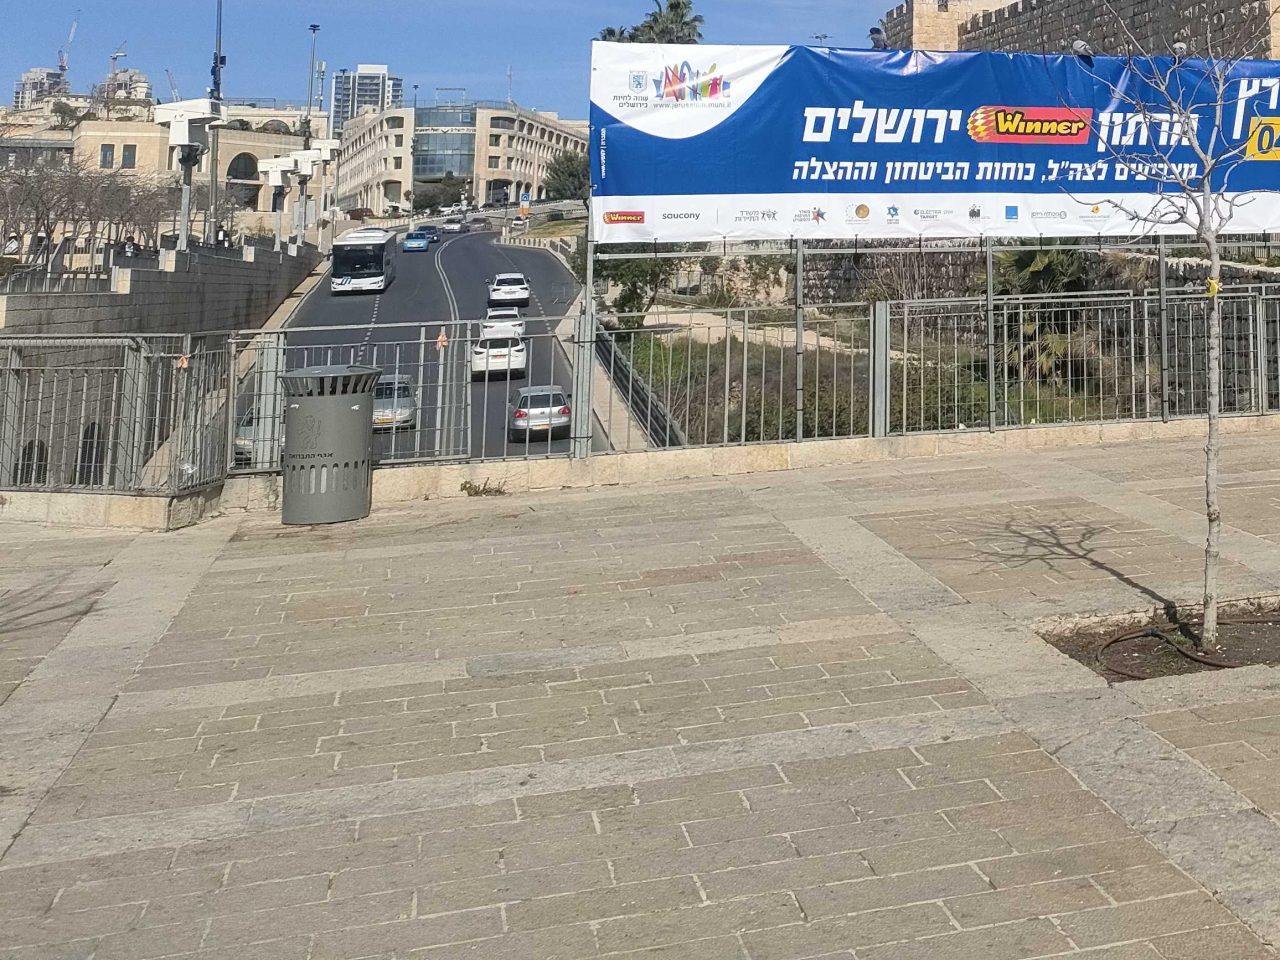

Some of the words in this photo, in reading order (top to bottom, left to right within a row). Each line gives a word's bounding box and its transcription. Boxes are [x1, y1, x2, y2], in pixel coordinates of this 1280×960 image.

[1232, 78, 1280, 139] רץ
[802, 100, 962, 143] ירושלים
[995, 110, 1086, 136] Winner
[1097, 113, 1199, 152] מרתון
[792, 157, 878, 180] וההצלה
[885, 161, 970, 184] הביטחון
[975, 161, 1035, 181] כוחות
[610, 213, 642, 222] Winner
[662, 212, 701, 221] saucony
